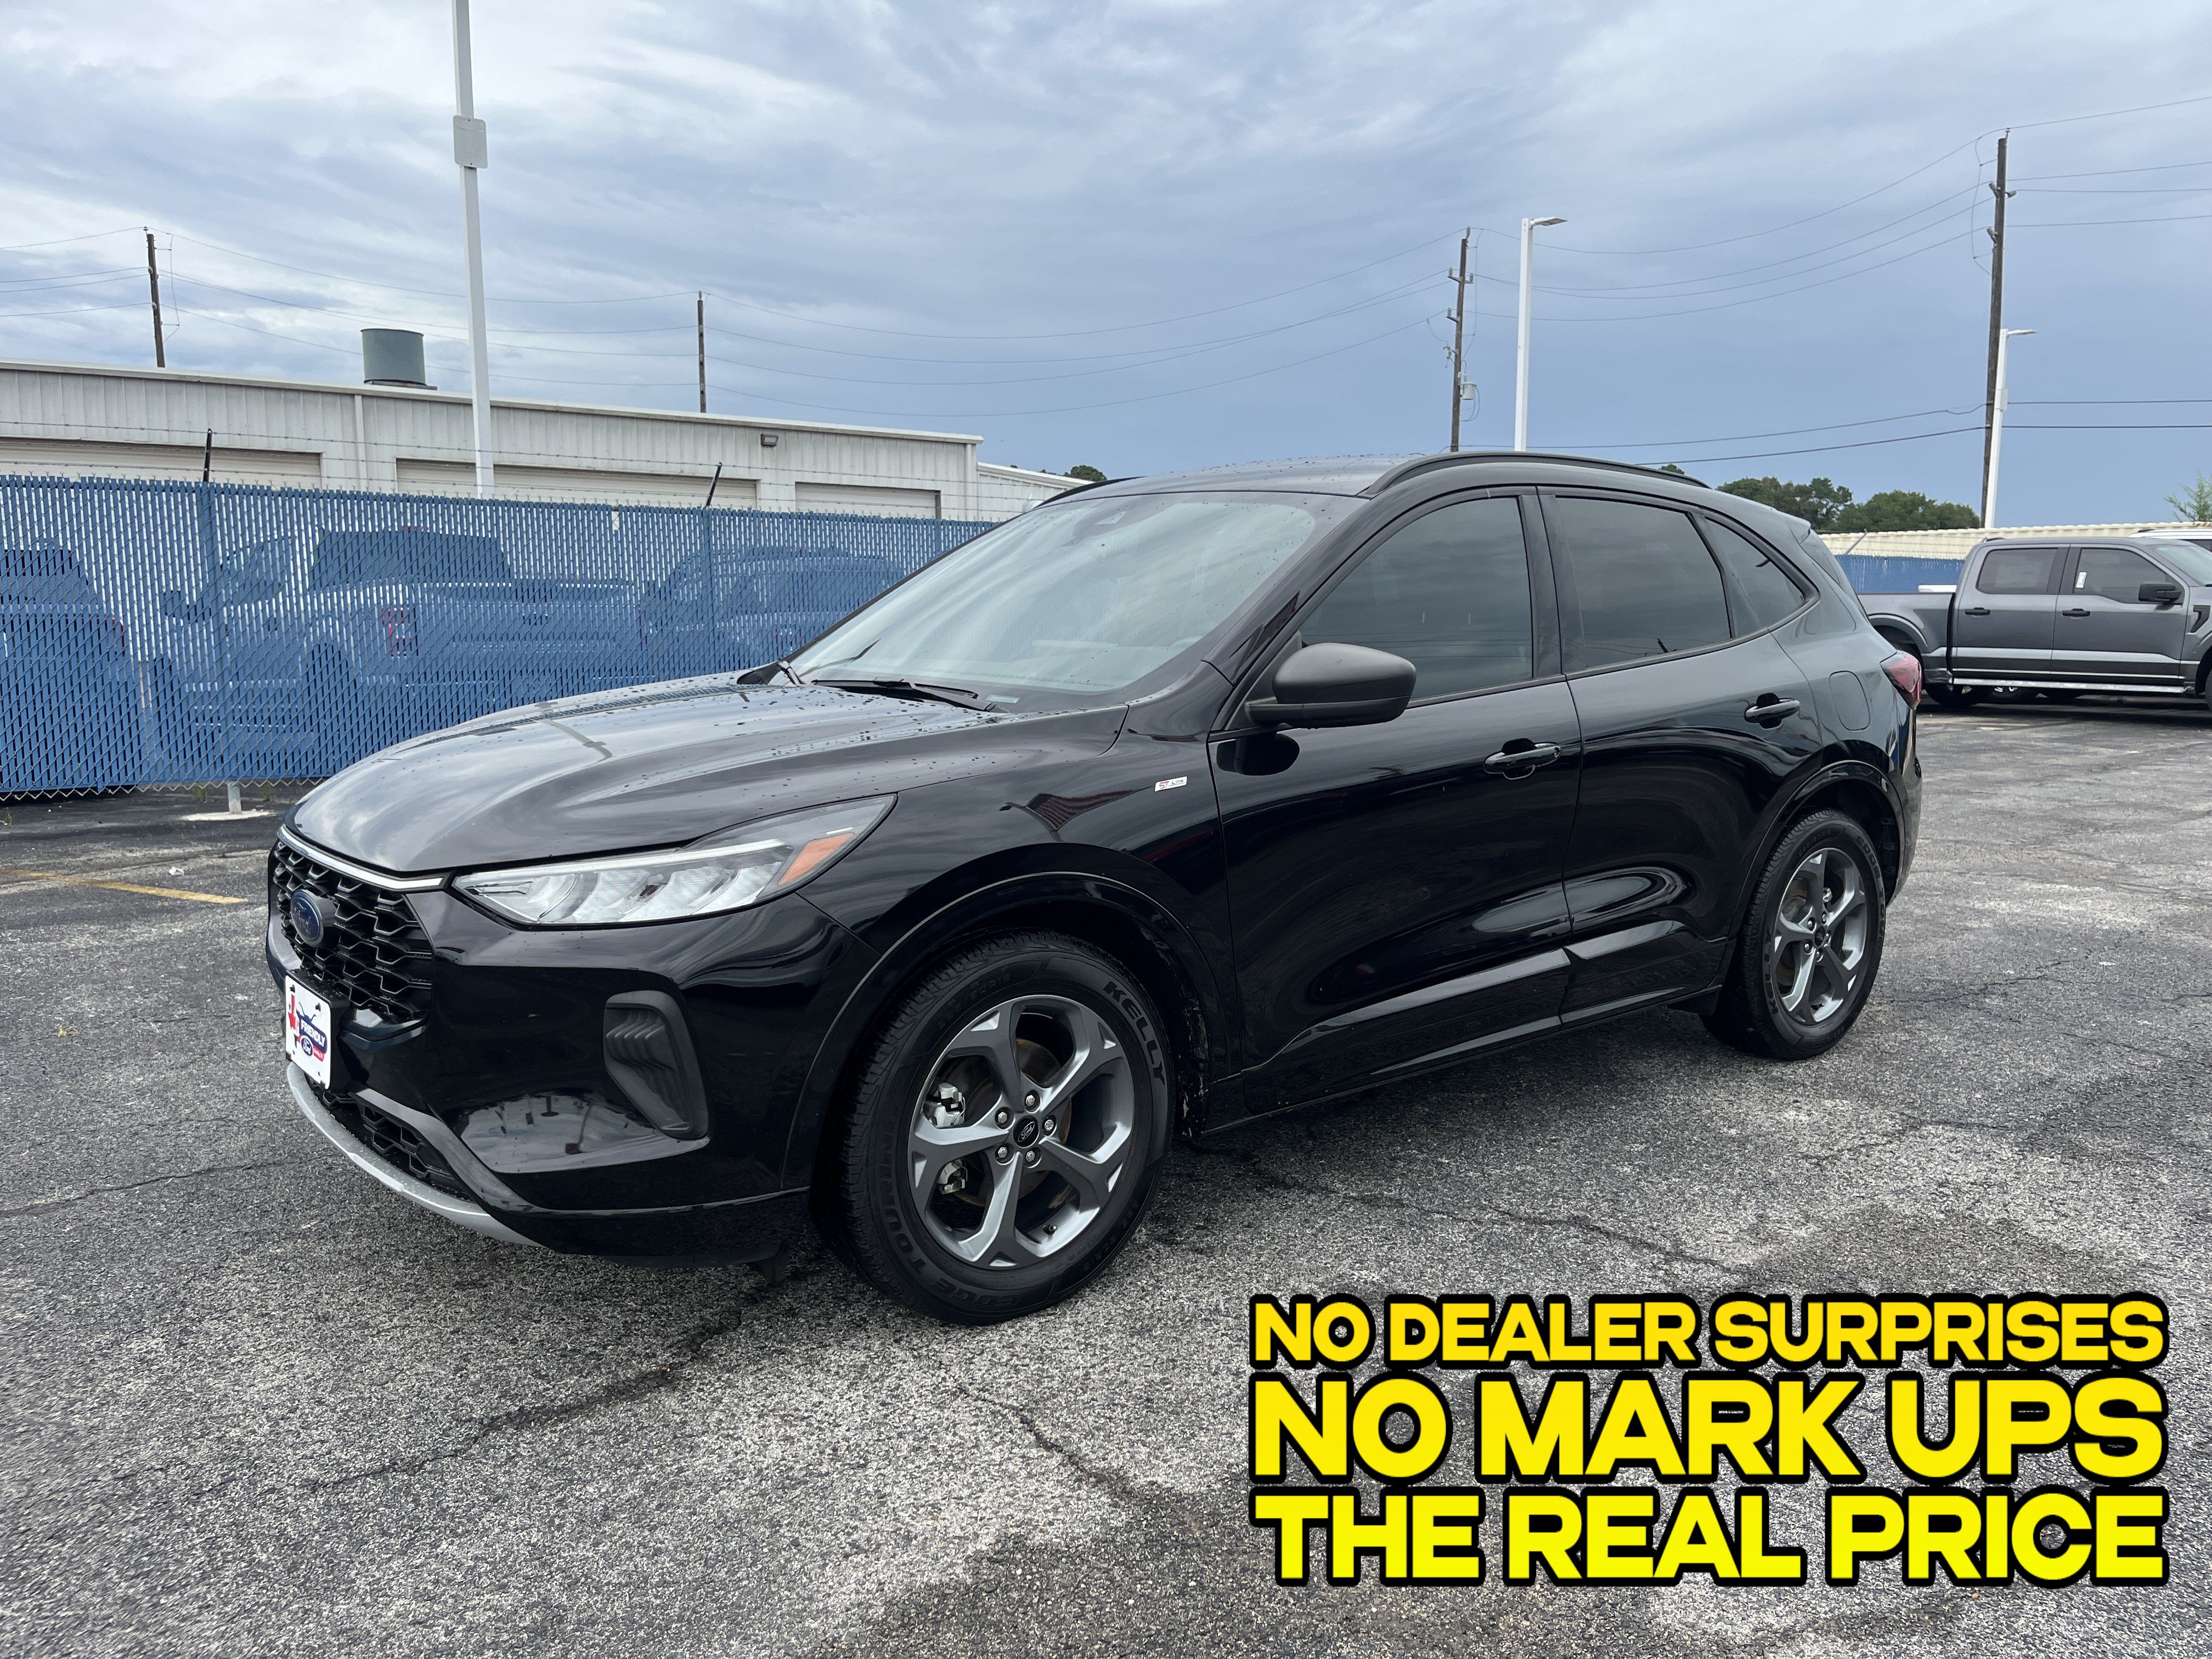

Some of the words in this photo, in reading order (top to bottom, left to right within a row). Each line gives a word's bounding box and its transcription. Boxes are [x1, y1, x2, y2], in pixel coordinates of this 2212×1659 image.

[301, 1019, 326, 1047] FRIENDLY
[1103, 980, 1165, 1086] KELLY
[1022, 1125, 1032, 1139] Ford
[931, 1277, 1022, 1307] EDGE
